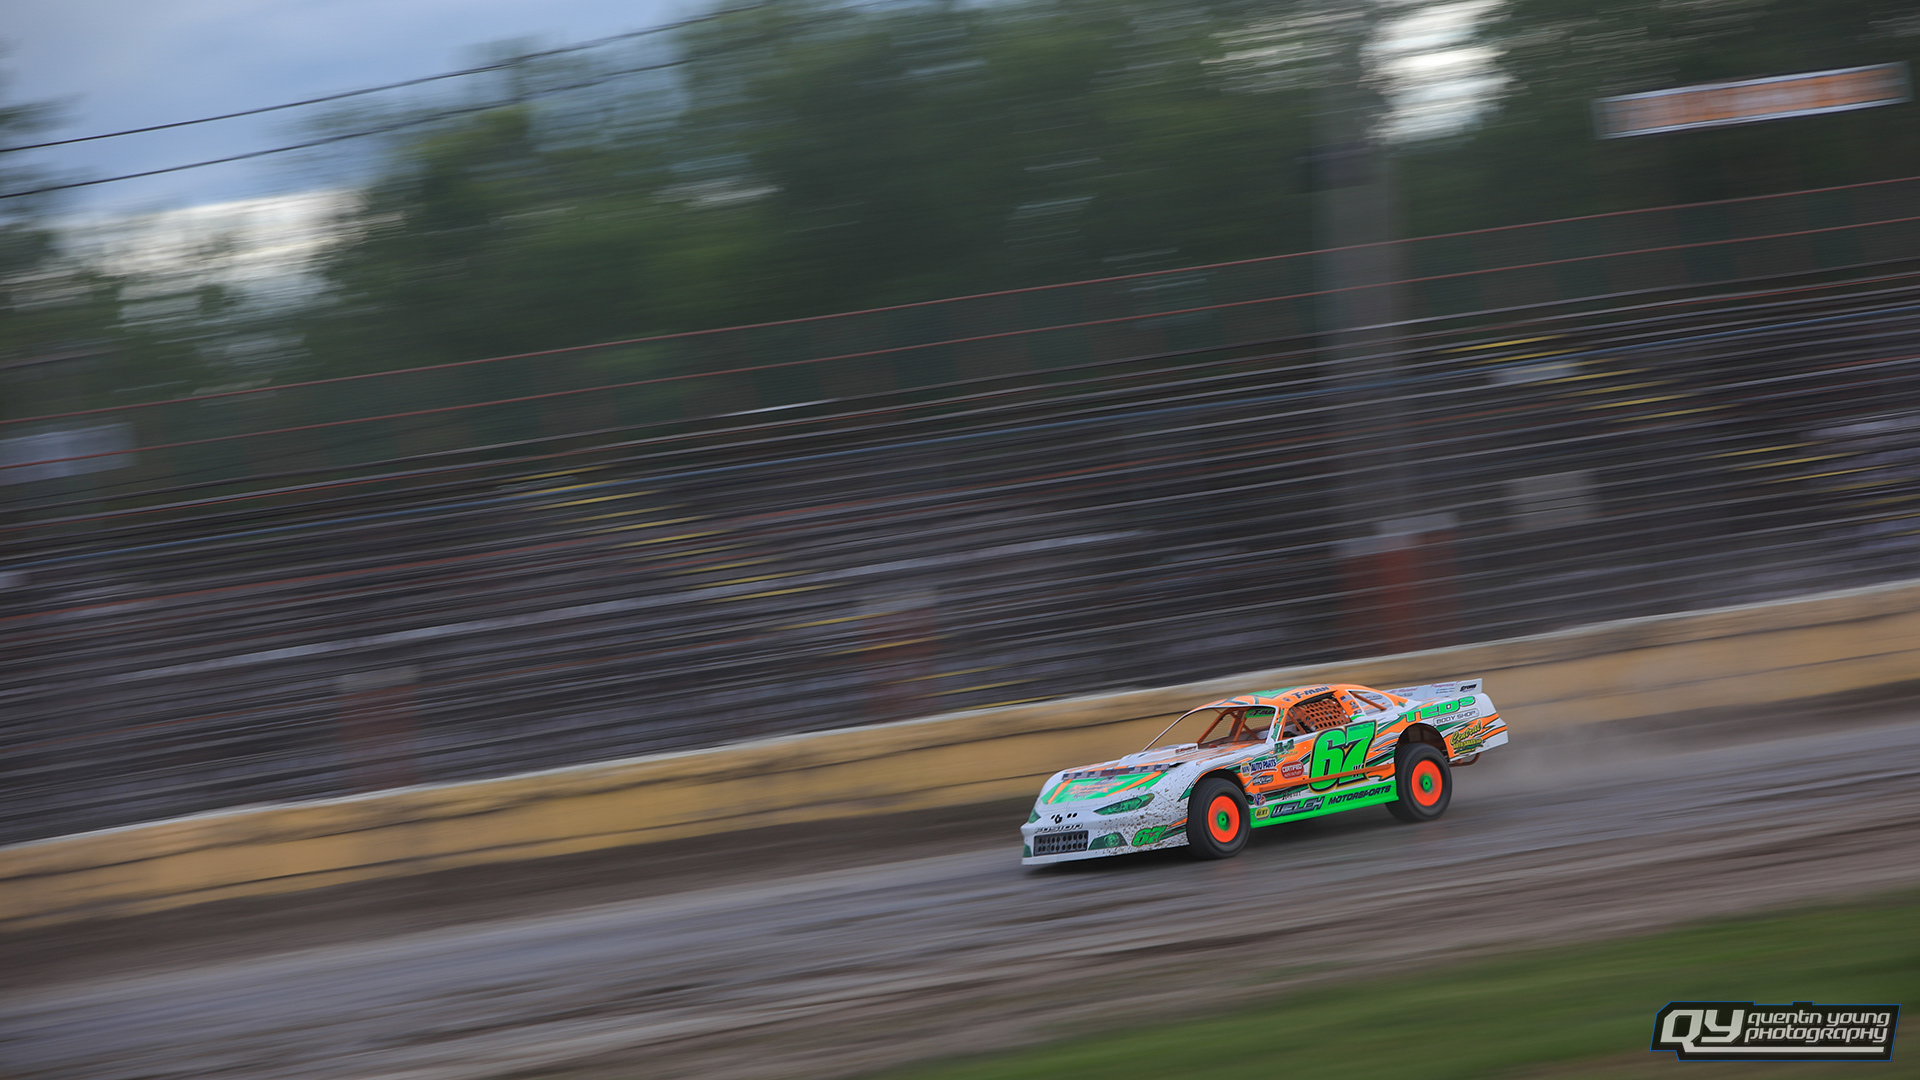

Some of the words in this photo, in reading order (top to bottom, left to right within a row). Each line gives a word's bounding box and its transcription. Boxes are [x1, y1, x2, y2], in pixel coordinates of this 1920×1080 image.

[1398, 696, 1476, 723] TEDS
[1436, 715, 1456, 724] BODY
[1456, 710, 1477, 720] SHOP
[1450, 720, 1483, 744] Central
[1251, 762, 1263, 772] AUTO
[1263, 758, 1277, 770] PARTS
[1309, 720, 1377, 793] 67
[1271, 796, 1325, 818] WELCH
[1328, 785, 1392, 805] MOTORSPORTS
[1035, 823, 1084, 834] FUSION
[1131, 825, 1168, 847] 67
